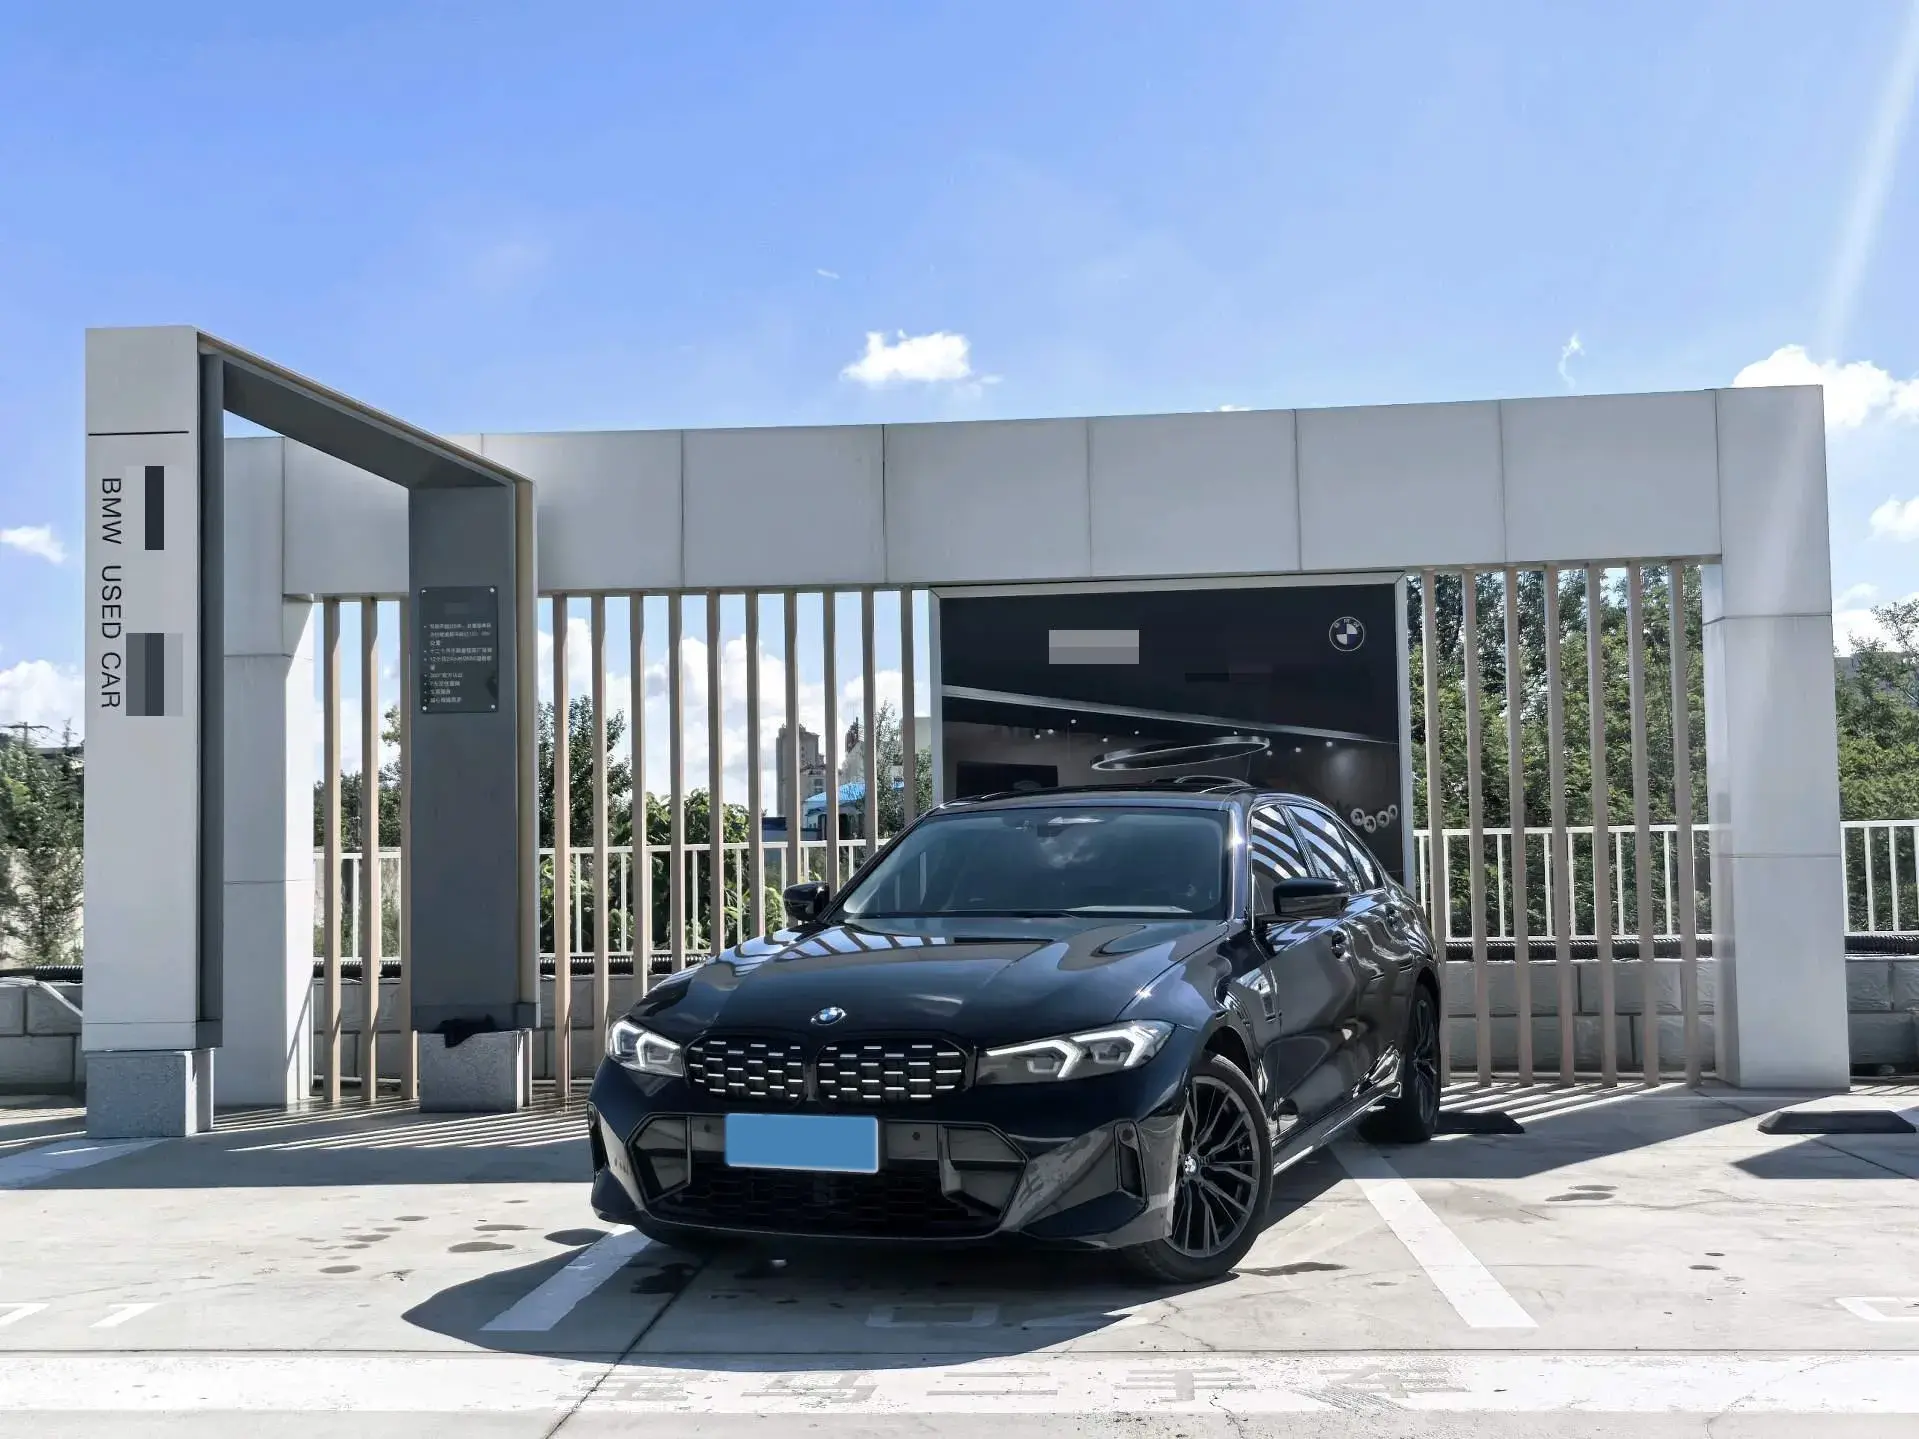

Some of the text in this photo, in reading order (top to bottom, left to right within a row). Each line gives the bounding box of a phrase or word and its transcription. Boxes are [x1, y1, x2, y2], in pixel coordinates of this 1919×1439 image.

[101, 477, 122, 709] BMW USED CAR
